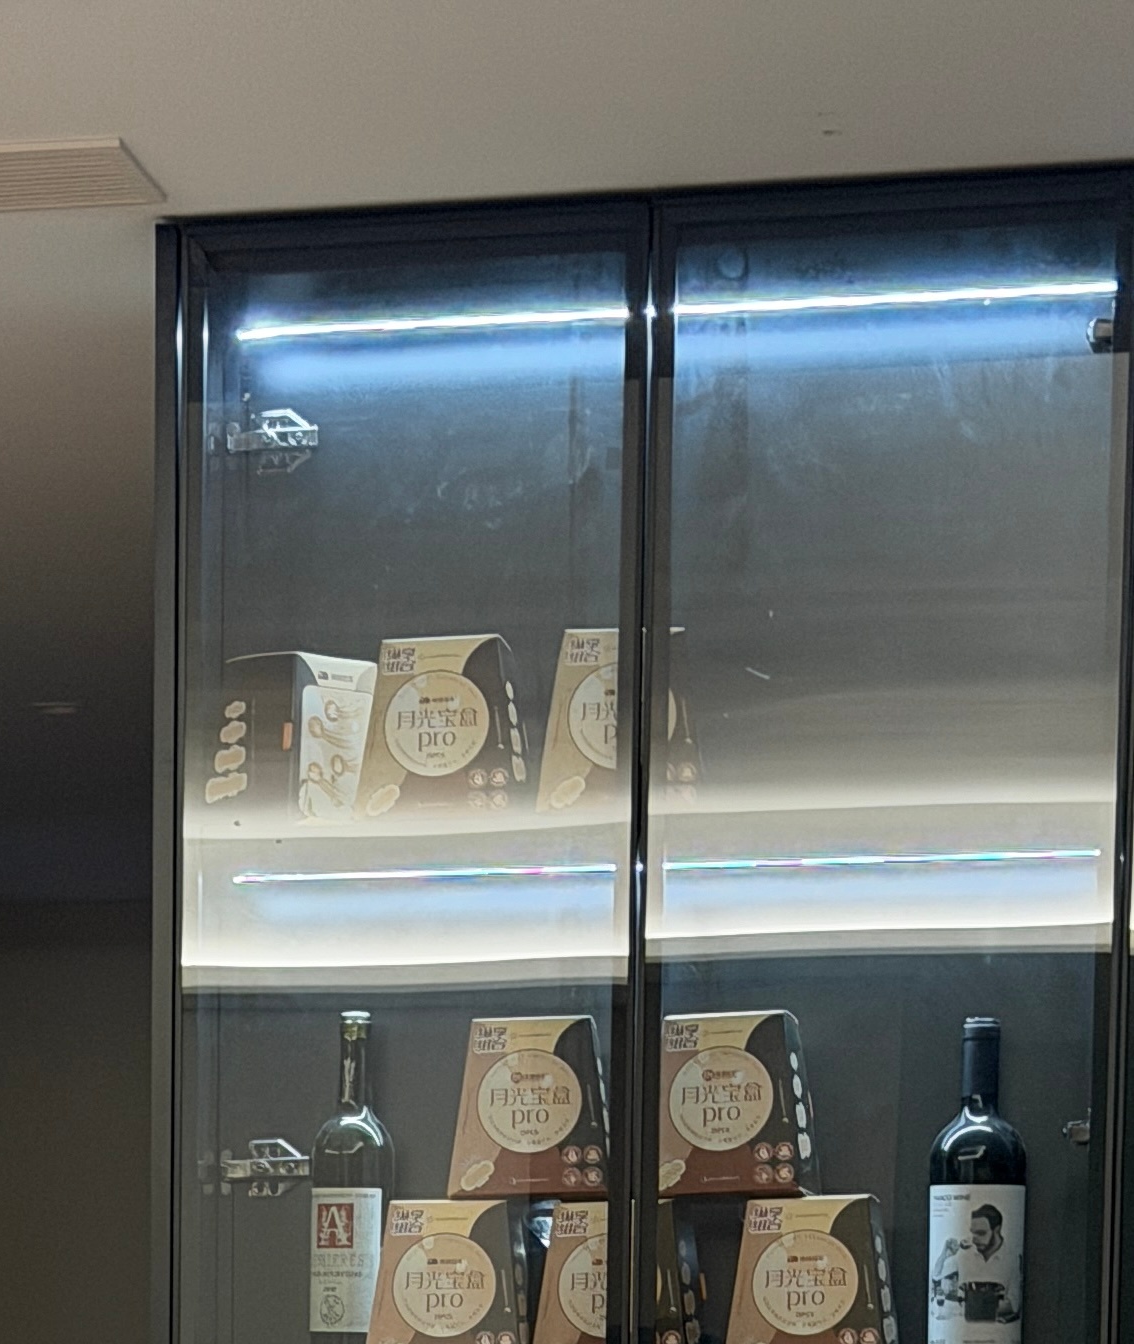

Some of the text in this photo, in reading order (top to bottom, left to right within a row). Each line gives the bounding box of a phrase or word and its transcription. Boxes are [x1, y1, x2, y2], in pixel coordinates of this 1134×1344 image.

[398, 707, 477, 730] 月光宝盒
[418, 731, 456, 752] pro
[490, 1086, 570, 1106] 月光宝盒
[682, 1082, 762, 1105] 月光宝盒
[511, 1109, 550, 1129] pro
[702, 1106, 741, 1128] pro
[405, 1270, 485, 1290] 月光宝盒
[765, 1267, 847, 1289] 月光宝盒
[426, 1293, 464, 1312] pro
[787, 1290, 825, 1312] pro
